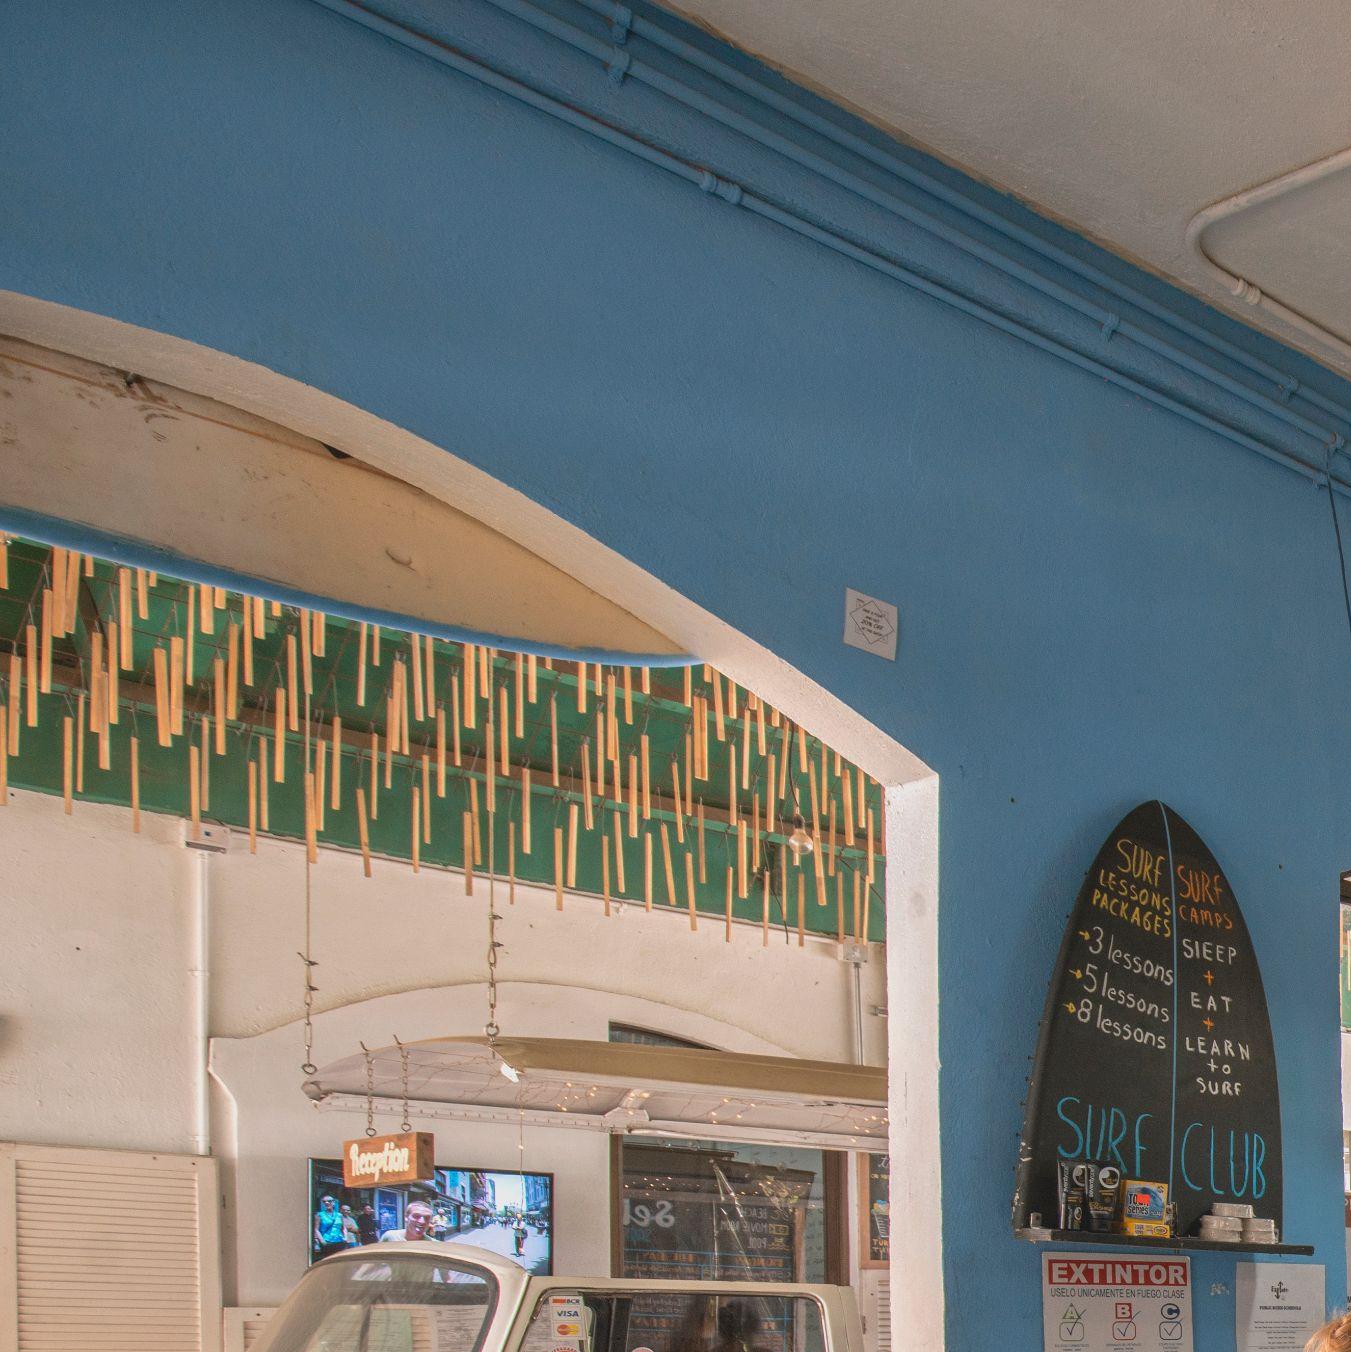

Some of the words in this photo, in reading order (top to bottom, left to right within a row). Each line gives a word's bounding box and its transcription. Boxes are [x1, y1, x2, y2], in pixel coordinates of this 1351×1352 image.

[1116, 838, 1166, 887] SURF
[1100, 869, 1172, 916] LESSONS
[1177, 865, 1222, 905] SURF
[1092, 888, 1172, 938] PACKAGES
[1178, 904, 1233, 930] CAMPS
[1088, 926, 1104, 954] 3
[1108, 934, 1175, 986] lessons
[1083, 963, 1098, 993] 5
[1101, 972, 1171, 1023] lessons
[1190, 991, 1233, 1013] EAT
[1077, 999, 1092, 1024] 8
[1096, 1004, 1167, 1050] lessons
[1185, 1036, 1250, 1061] LEARN
[1207, 1058, 1232, 1076] to
[1196, 1077, 1243, 1097] SURF
[349, 1141, 410, 1182] Reception
[1056, 1096, 1153, 1178] SURF
[1181, 1122, 1266, 1199] CLUB
[1051, 1288, 1076, 1298] USELO
[1125, 1289, 1136, 1298] EN
[1136, 1289, 1162, 1299] FUEGO
[1162, 1289, 1185, 1299] CLASE
[1052, 1262, 1186, 1285] EXTINTOR
